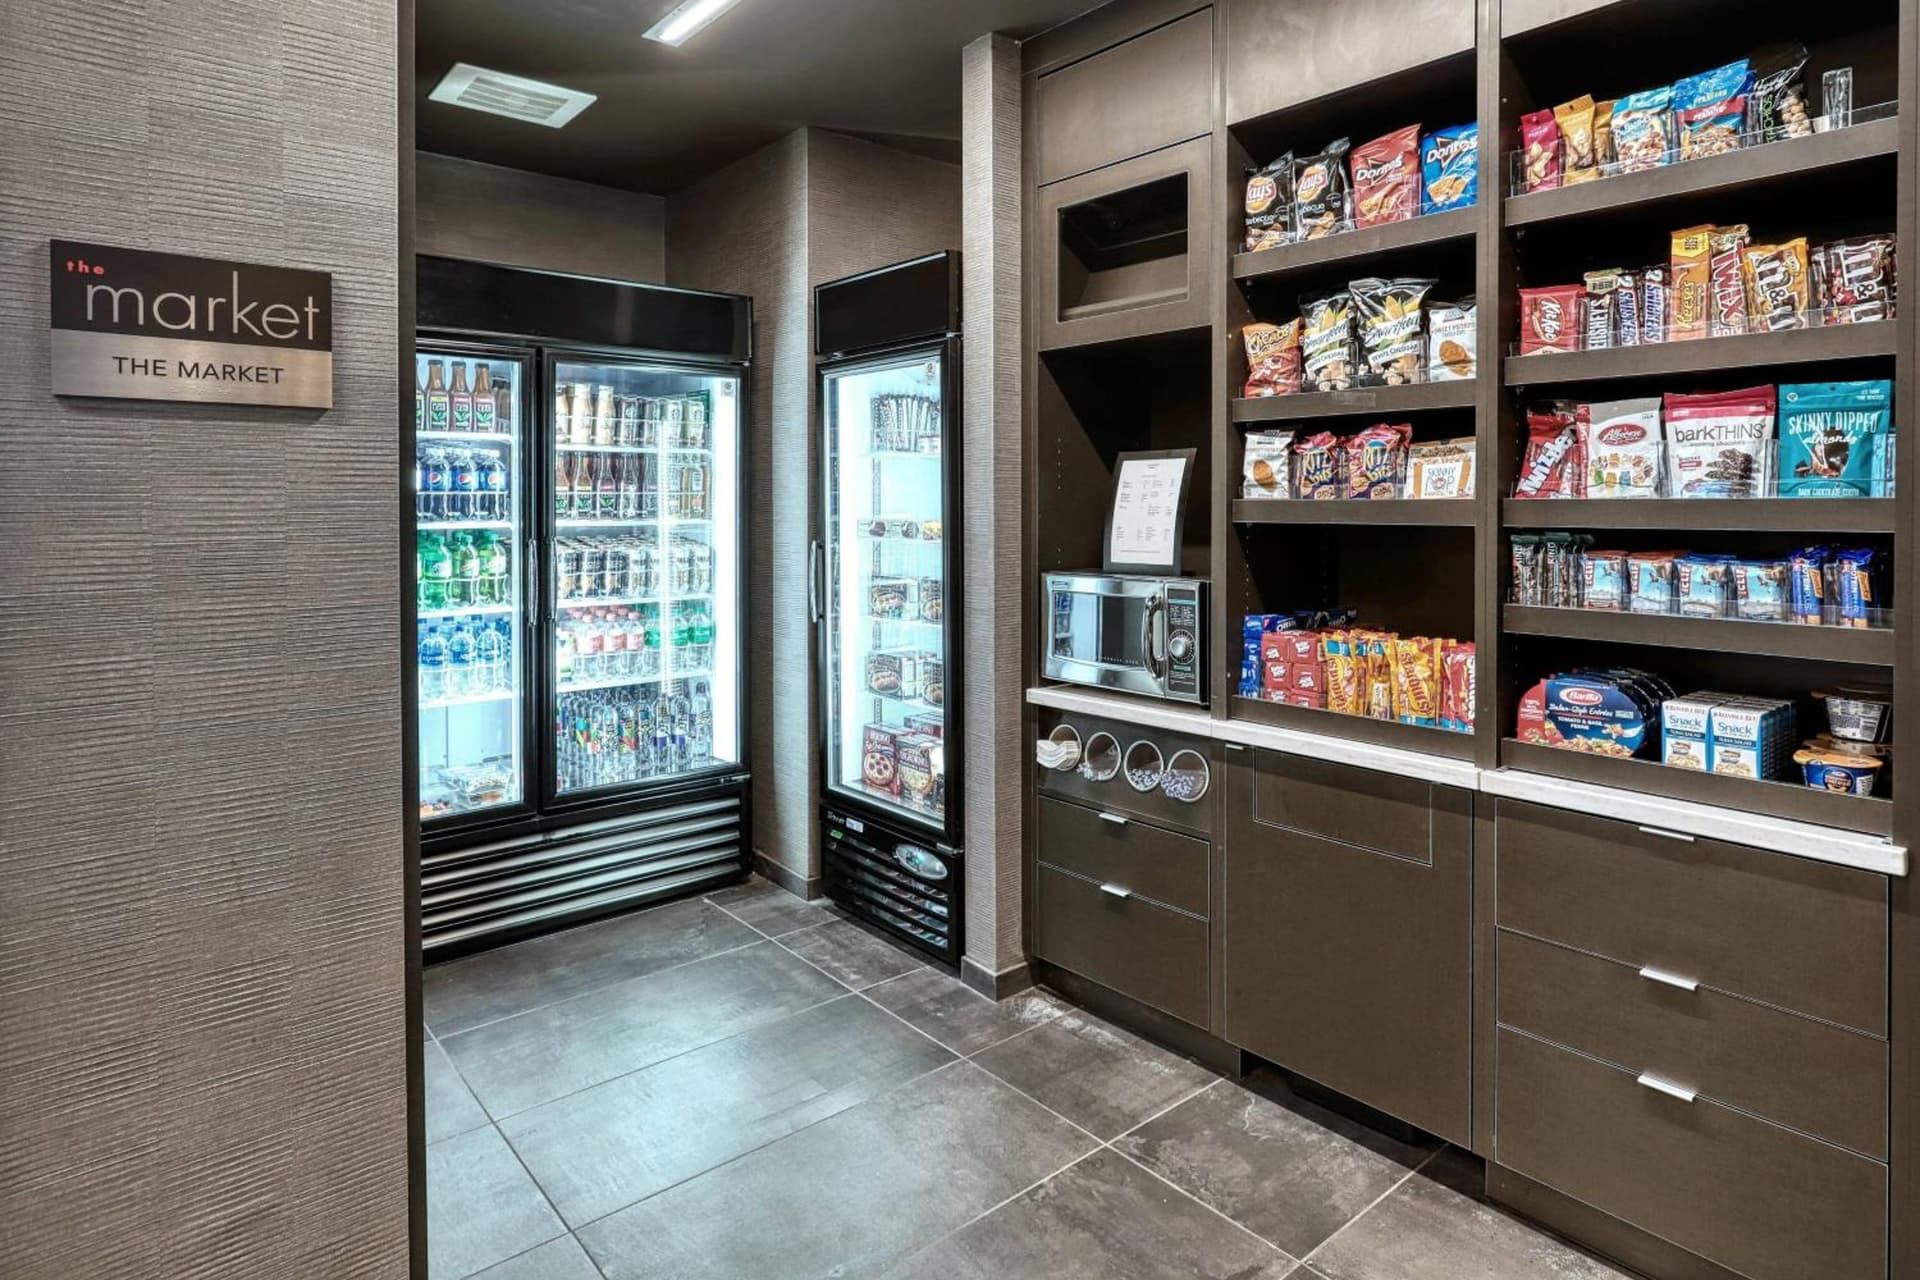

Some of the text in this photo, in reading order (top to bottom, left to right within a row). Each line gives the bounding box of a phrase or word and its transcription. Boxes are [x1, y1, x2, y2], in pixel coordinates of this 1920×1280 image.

[1426, 136, 1478, 163] Doritos
[1356, 152, 1404, 181] Doritos
[66, 260, 104, 275] the
[1711, 240, 1745, 321] TWIX
[87, 271, 320, 340] market
[1618, 290, 1636, 346] SNICKERS
[1645, 284, 1662, 342] SNICKERS
[112, 357, 284, 384] THE MARKET
[1675, 423, 1764, 443] barkTHINS
[1788, 411, 1879, 435] SKINNY DIPPED
[1428, 466, 1456, 476] SKINNY
[1568, 690, 1599, 701] Barilla
[1669, 714, 1702, 728] Snack
[1718, 721, 1752, 735] Snack
